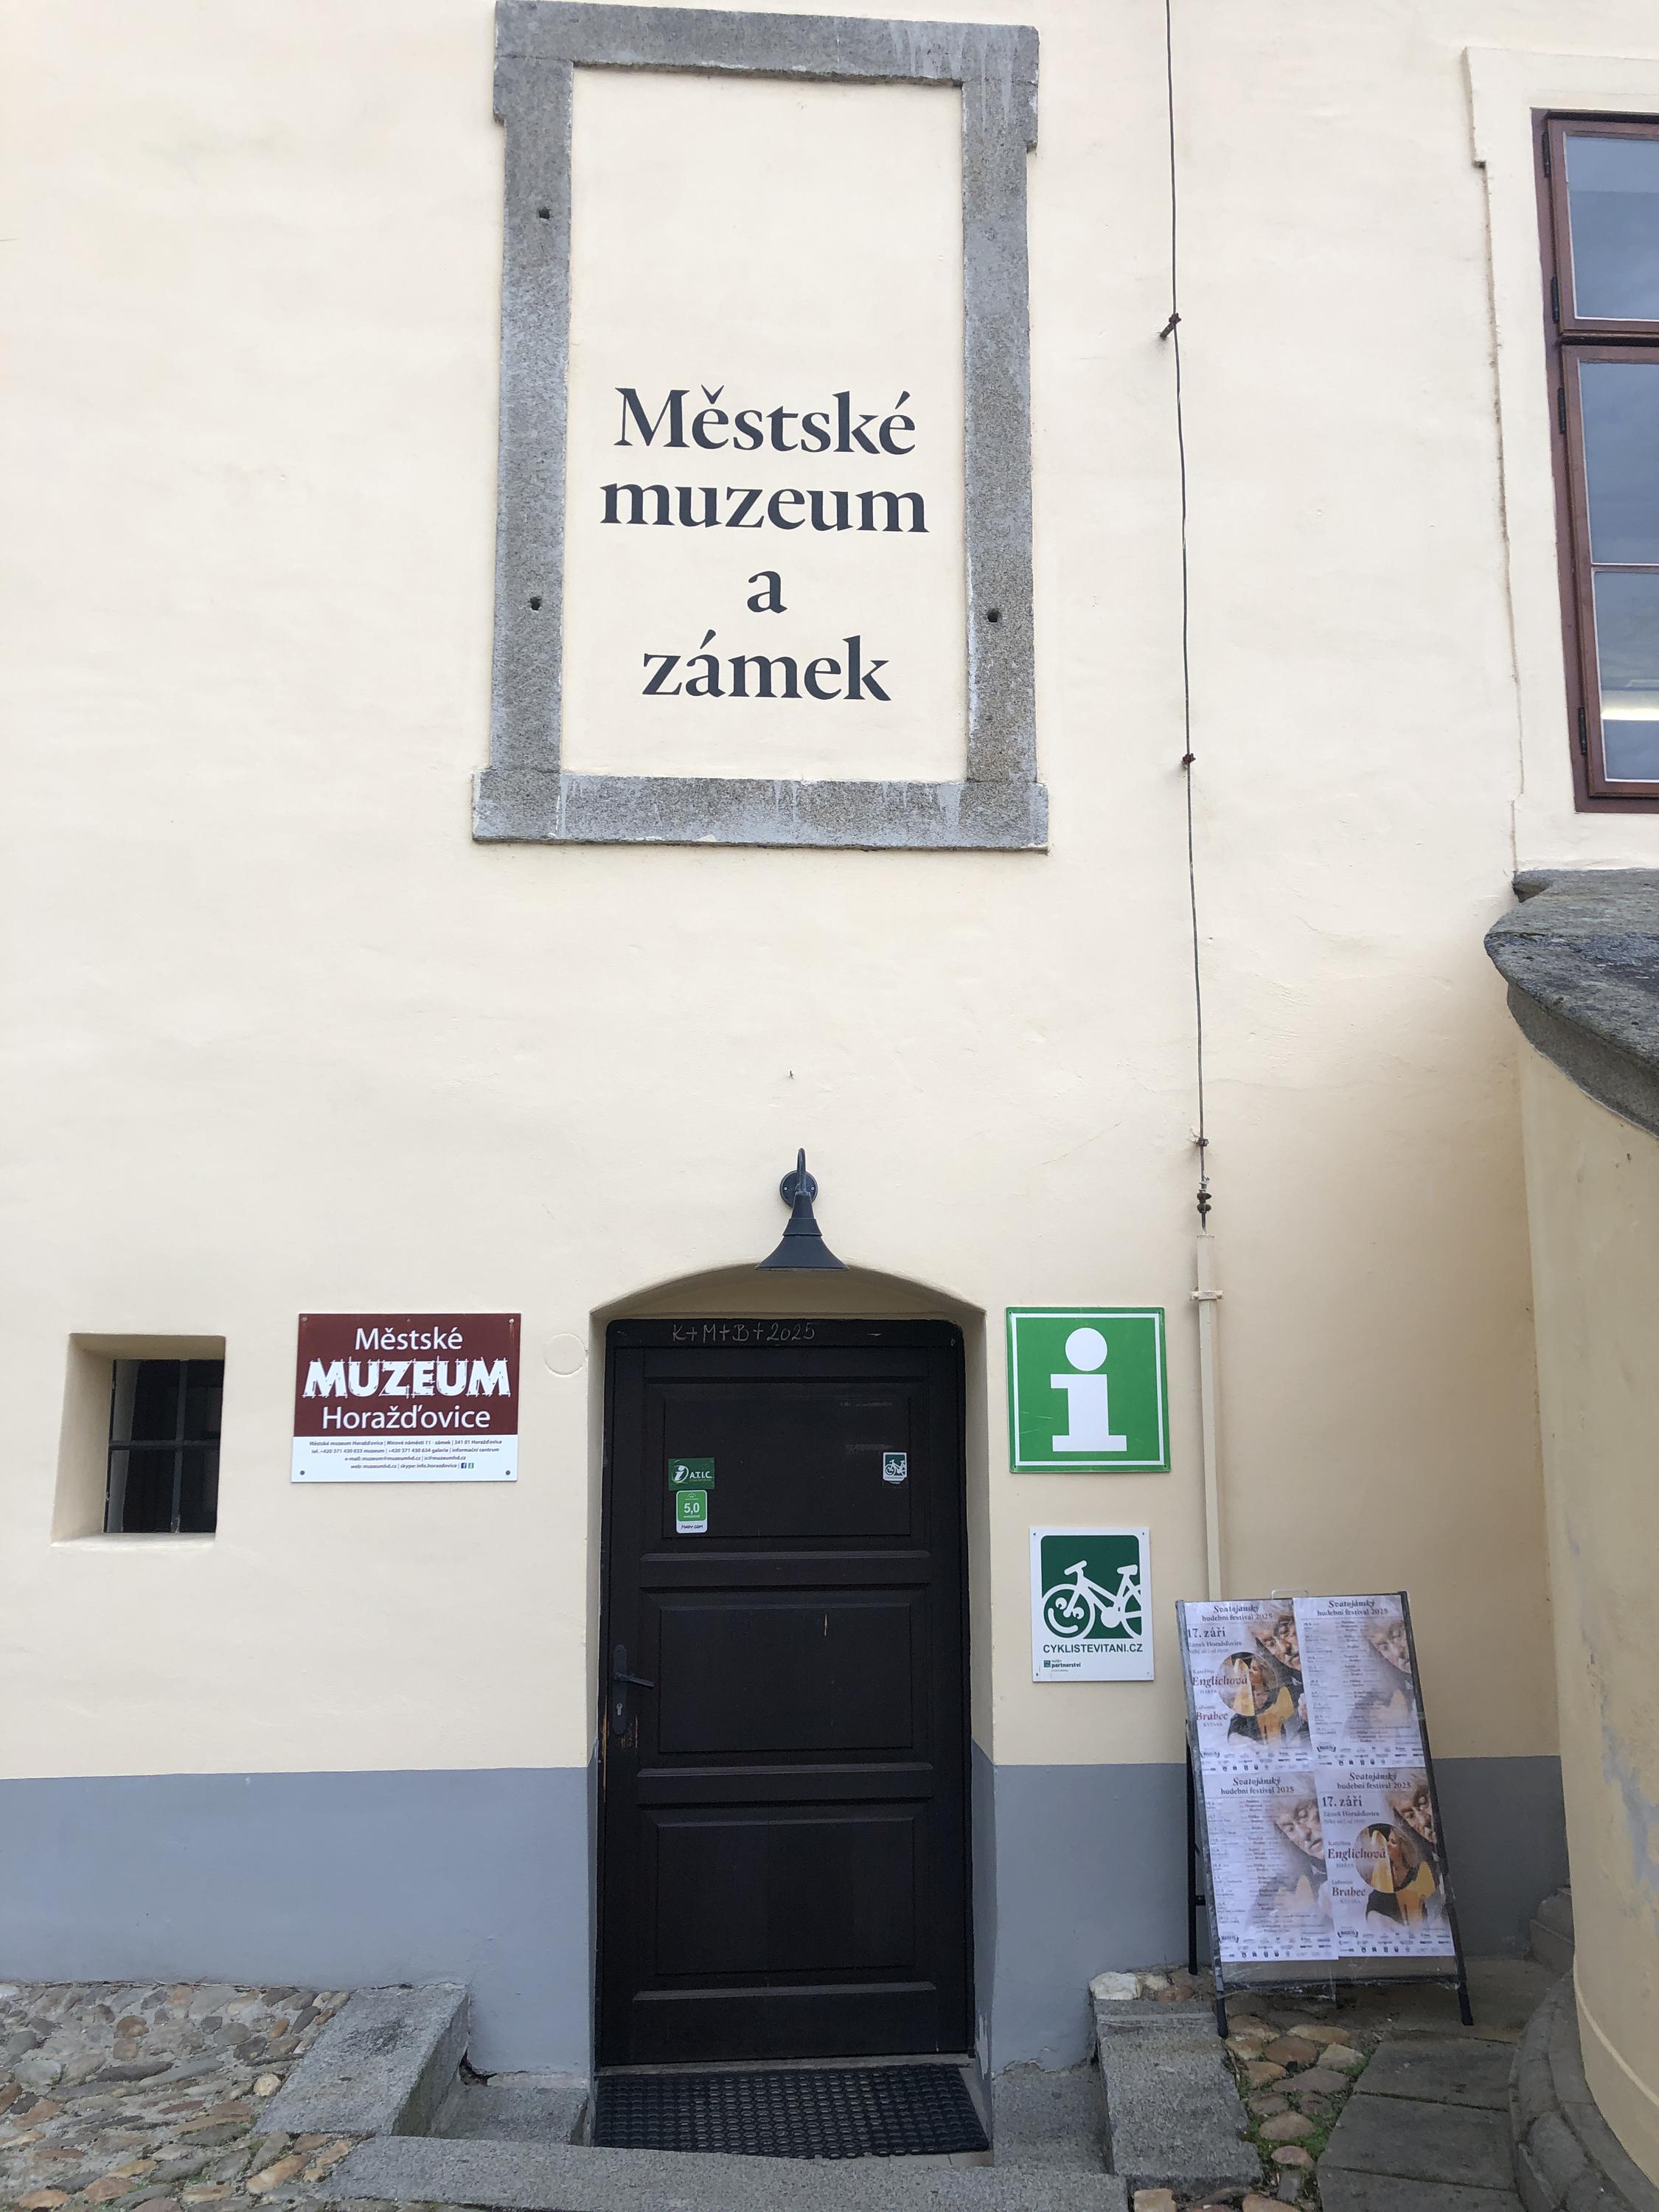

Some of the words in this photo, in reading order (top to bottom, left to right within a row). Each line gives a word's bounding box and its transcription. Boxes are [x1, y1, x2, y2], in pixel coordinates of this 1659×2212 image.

[613, 384, 916, 455] Městské
[599, 483, 930, 532] muzeum
[747, 571, 787, 613] a
[642, 629, 891, 701] zámek
[355, 1326, 463, 1350] Městské
[302, 1355, 511, 1399] MUZEUM
[322, 1404, 490, 1429] Horažďovice
[684, 1503, 700, 1514] 5,0
[1204, 1627, 1226, 1638] září
[1043, 1644, 1143, 1653] CYKLISTEVITANI.CZ
[1192, 1675, 1248, 1688] Englichová
[1196, 1711, 1228, 1720] Brabec
[1233, 1777, 1281, 1787] Svatojánský
[1349, 1773, 1397, 1781] Svatojánský
[1323, 1796, 1337, 1806] 17.
[1339, 1795, 1363, 1806] září
[1328, 1848, 1386, 1862] Englichová
[1332, 1887, 1366, 1896] Brabec
